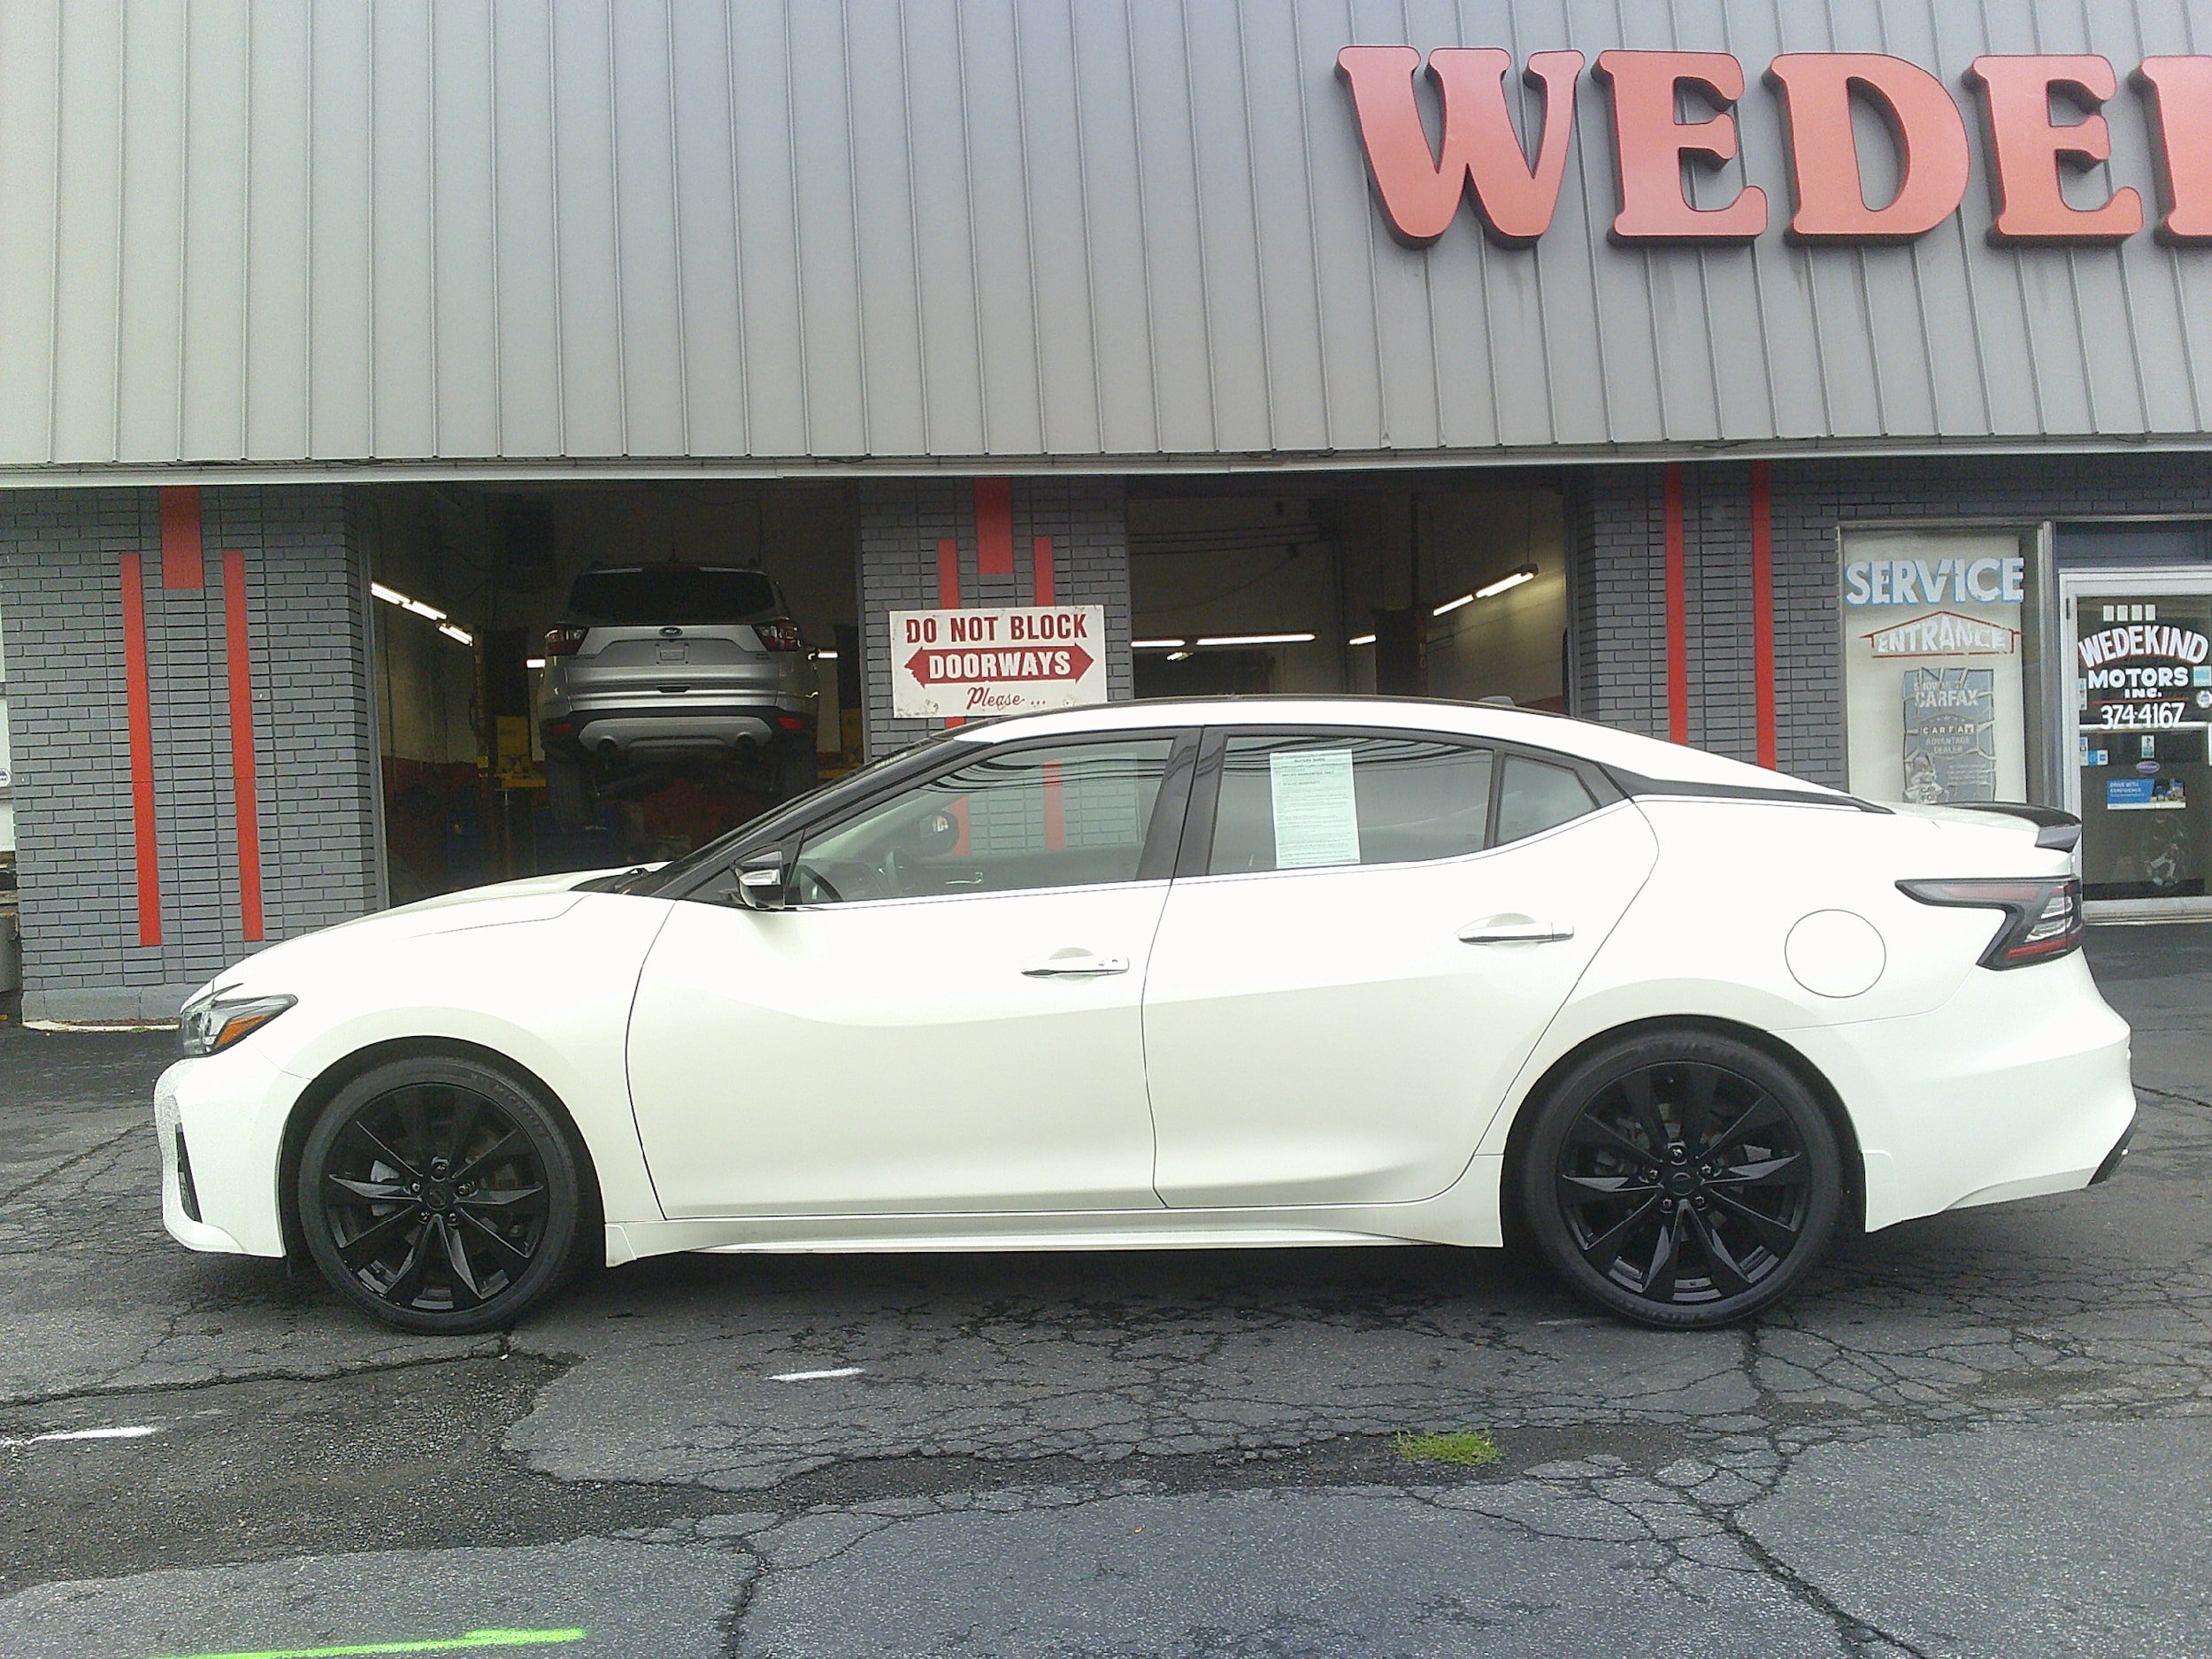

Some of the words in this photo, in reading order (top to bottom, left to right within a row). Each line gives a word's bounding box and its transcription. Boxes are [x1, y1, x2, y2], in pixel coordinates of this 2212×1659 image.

[1335, 44, 2212, 245] WEDE
[1844, 557, 2025, 606] SERVICE
[905, 618, 938, 644] DO
[950, 616, 999, 642] NOT
[1010, 613, 1087, 641] BLOCK
[1877, 615, 2007, 653] ENTRANCE
[2078, 625, 2209, 669] WEDEKIND
[929, 650, 1071, 680] DOORWAYS
[2088, 666, 2189, 689] MOTORS
[966, 687, 1025, 710] Please
[1914, 688, 1979, 708] CARFAX
[2124, 687, 2162, 699] INC.
